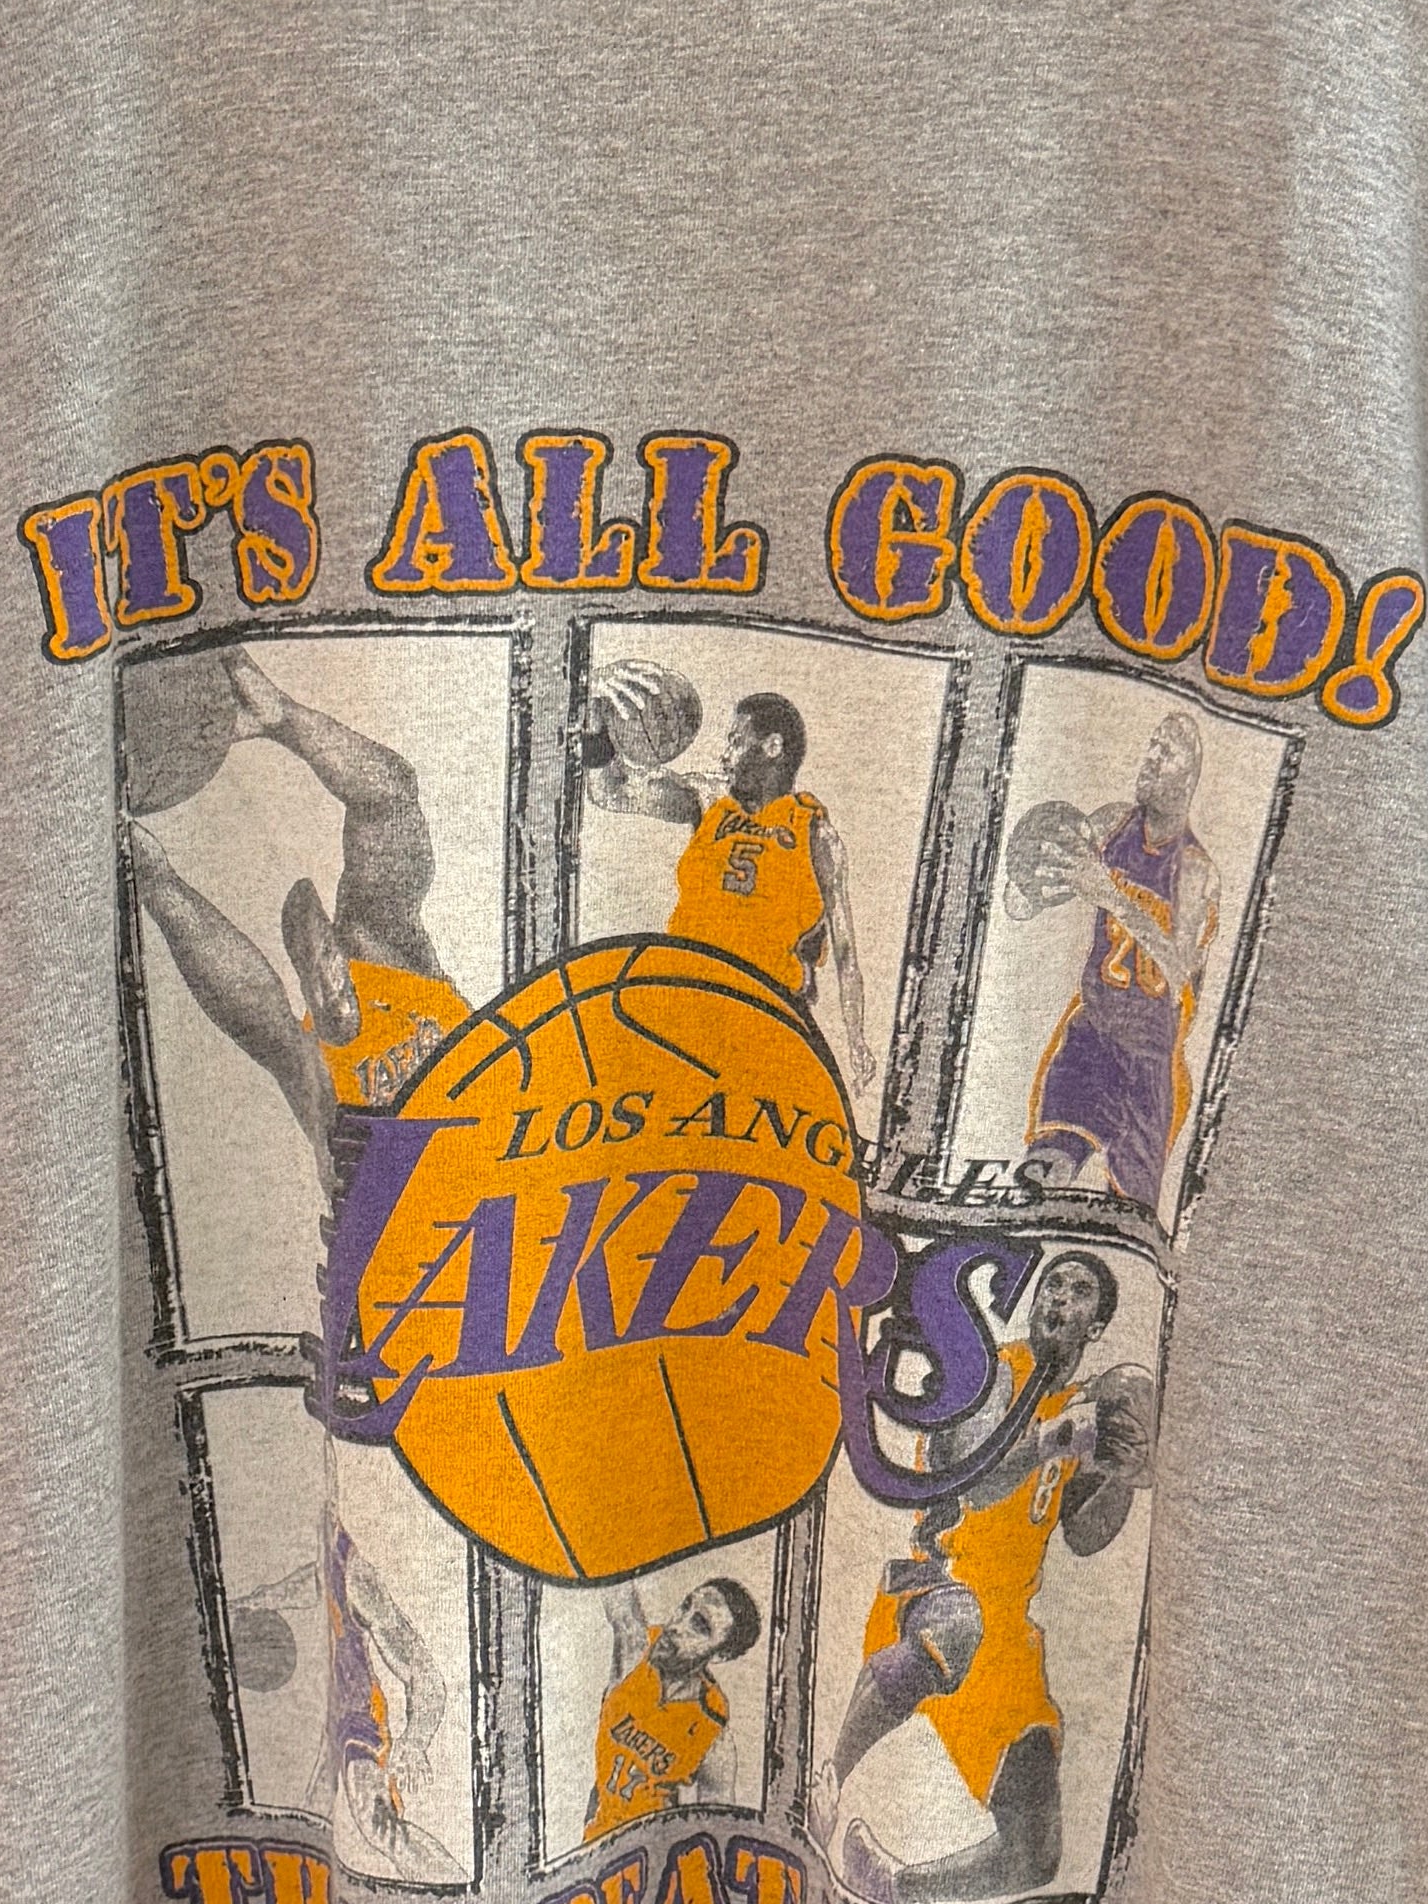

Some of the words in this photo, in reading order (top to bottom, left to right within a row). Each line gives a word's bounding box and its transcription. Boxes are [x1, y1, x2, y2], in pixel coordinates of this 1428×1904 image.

[19, 438, 320, 662] IT'S
[364, 428, 765, 598] ALL
[825, 453, 1426, 730] GOOD!
[723, 842, 765, 896] 5
[496, 1090, 656, 1163] LOS
[304, 1112, 1056, 1509] LAKERS
[1029, 1458, 1061, 1524] 8
[606, 1754, 648, 1802] 17
